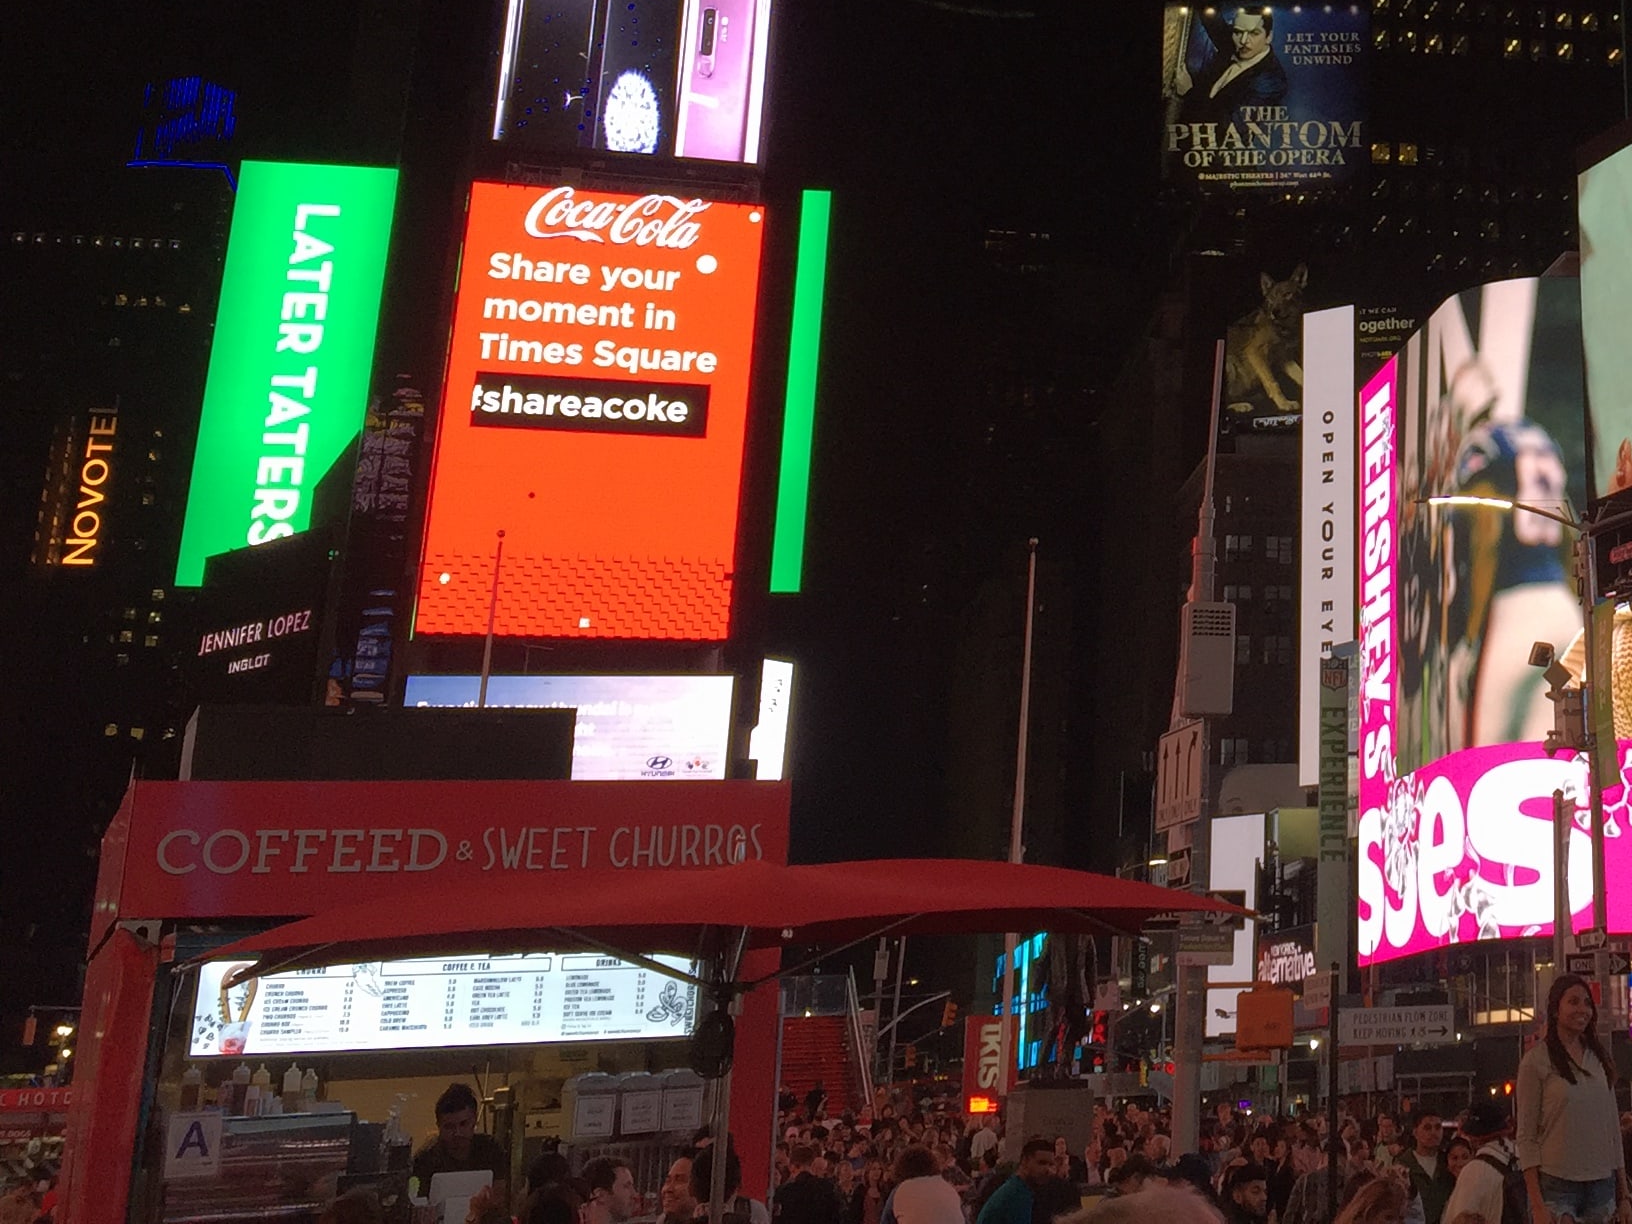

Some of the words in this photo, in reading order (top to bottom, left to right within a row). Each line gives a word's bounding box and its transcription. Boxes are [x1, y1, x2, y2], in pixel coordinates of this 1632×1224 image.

[1284, 43, 1361, 54] FANTASIES
[1287, 33, 1314, 43] LET
[1320, 32, 1360, 42] YOUR
[1293, 54, 1352, 65] UNWIND
[1240, 106, 1289, 122] THE
[1168, 120, 1363, 152] PHANTOM
[1183, 150, 1217, 168] OF
[1219, 150, 1266, 167] THE
[1269, 148, 1346, 167] OPERA
[525, 186, 711, 249] Coca-Cola
[276, 203, 341, 353] LATER
[488, 252, 590, 285] Share
[600, 266, 681, 292] your
[483, 295, 635, 329] moment
[644, 302, 676, 331] in
[479, 332, 583, 367] Times
[592, 340, 717, 374] Square
[247, 366, 318, 547] TATERS
[1321, 410, 1335, 484] OPEN
[62, 394, 120, 566] NOVOTEL
[1320, 501, 1335, 580] YOUR
[1363, 381, 1393, 778] HERSHEY'S
[198, 622, 263, 656] JENNIFER
[267, 609, 311, 638] LOPEZ
[228, 651, 271, 674] INGLOT
[1321, 706, 1347, 863] EXPERIENCE
[156, 828, 448, 876] COFFEED
[456, 839, 474, 863] &
[481, 826, 597, 872] SWEET
[609, 823, 765, 869] CHURROS
[443, 963, 468, 972] COFFEE
[478, 962, 491, 971] TEA
[1352, 1012, 1403, 1025] PEDESTRIAN
[1429, 1010, 1449, 1022] ZONE
[1352, 1028, 1371, 1040] KEEP
[1375, 1027, 1407, 1039] MOVING
[175, 1121, 210, 1160] A
